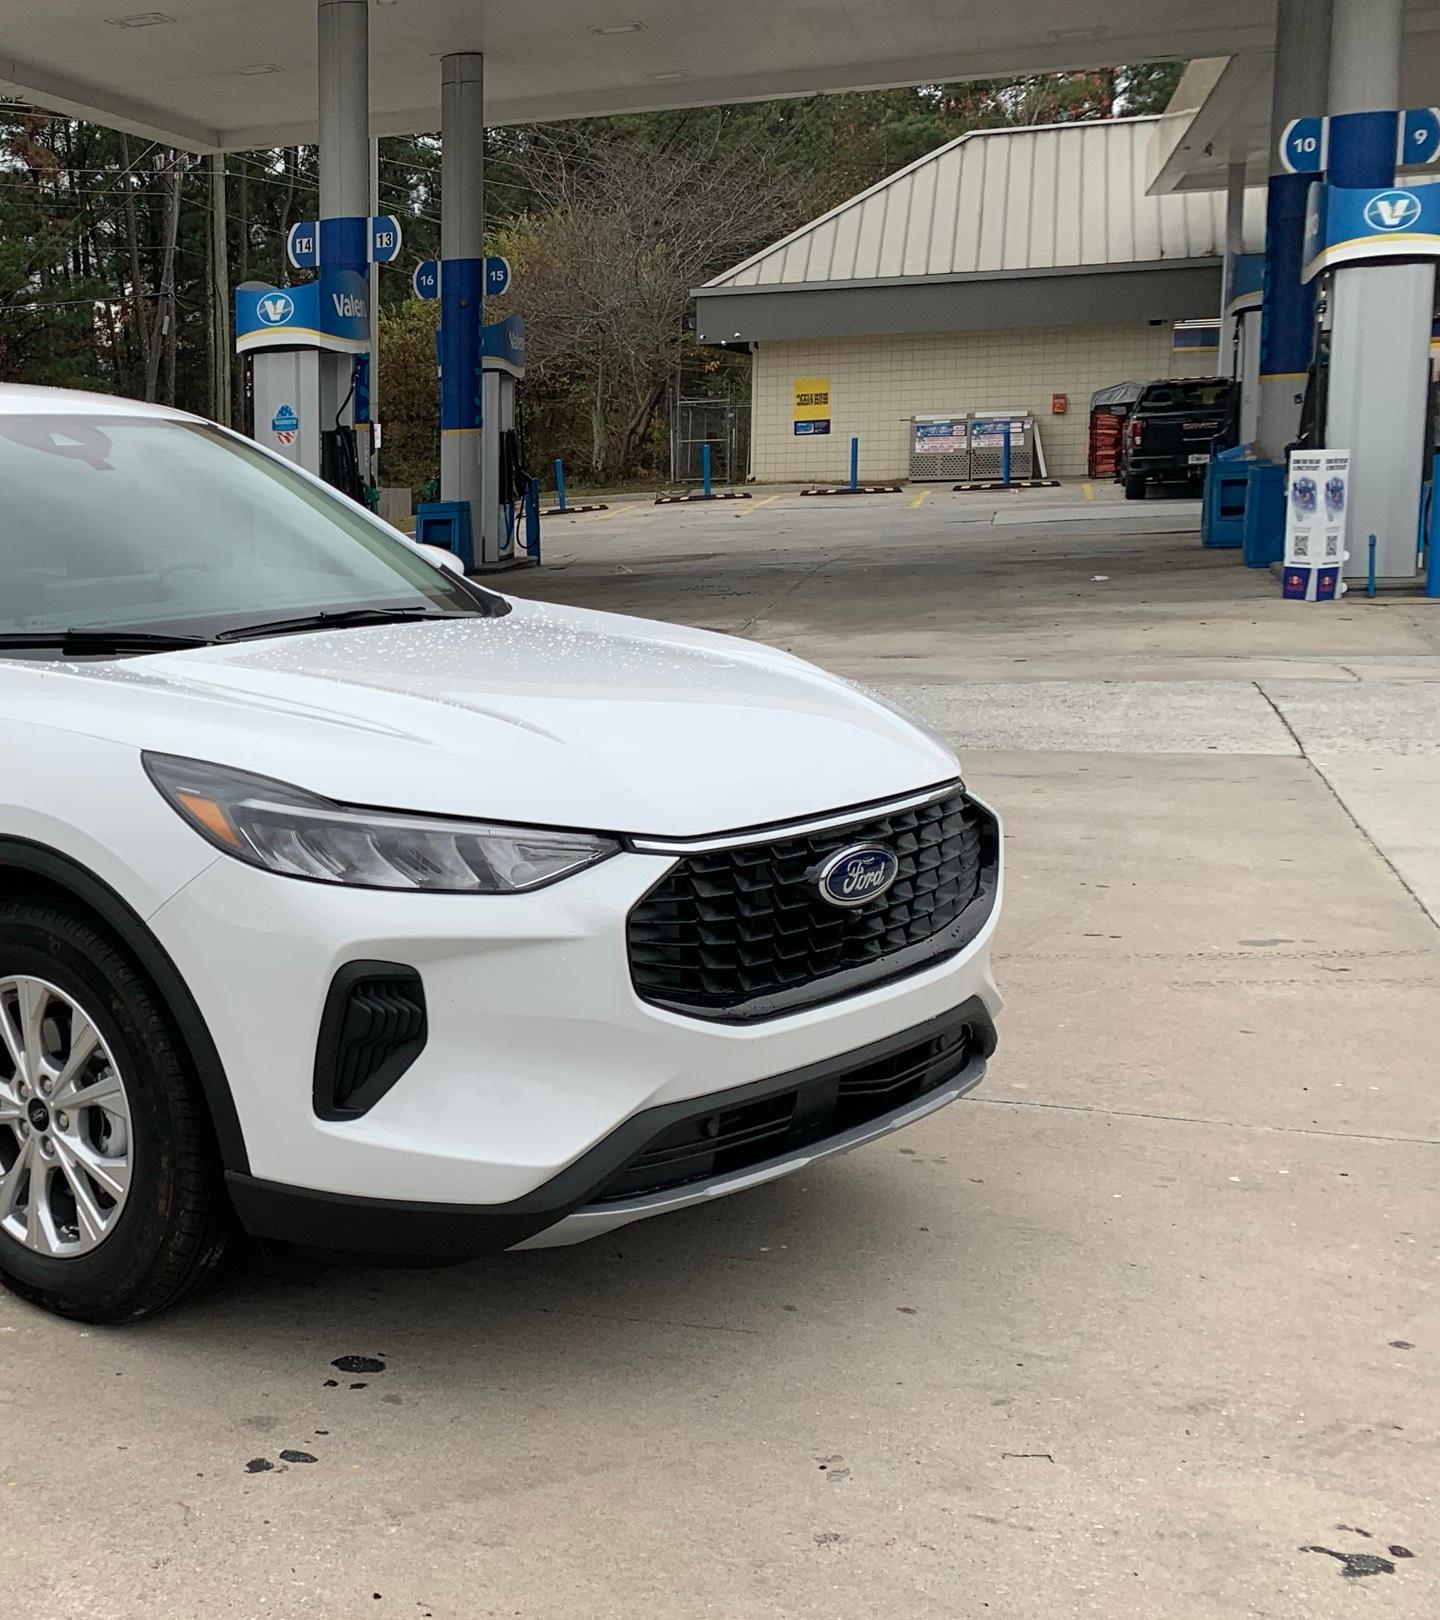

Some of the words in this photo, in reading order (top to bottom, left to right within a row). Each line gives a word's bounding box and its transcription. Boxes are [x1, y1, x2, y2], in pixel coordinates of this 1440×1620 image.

[1414, 129, 1428, 146] 9
[1293, 137, 1317, 153] 10
[298, 239, 311, 252] 14
[378, 233, 392, 247] 13
[420, 275, 434, 286] 16
[490, 270, 504, 282] 15
[843, 857, 885, 894] Ford
